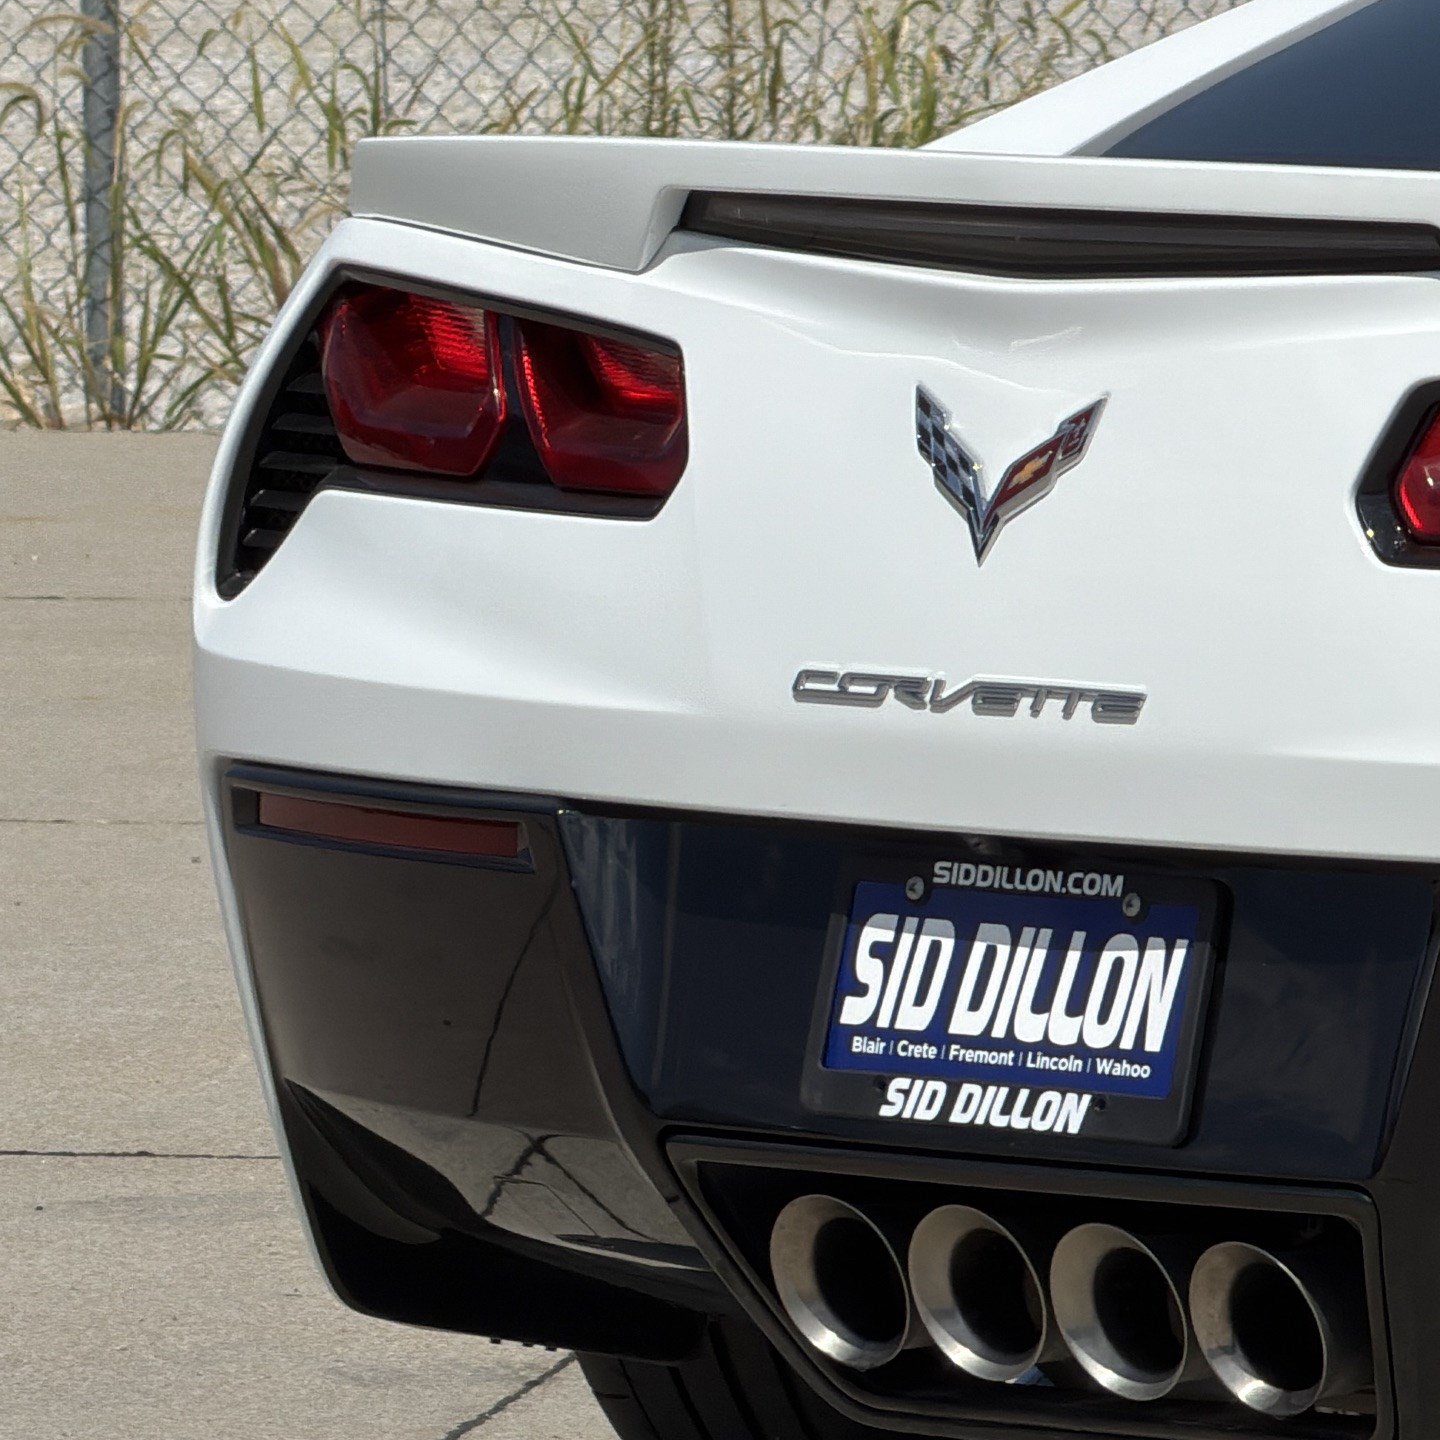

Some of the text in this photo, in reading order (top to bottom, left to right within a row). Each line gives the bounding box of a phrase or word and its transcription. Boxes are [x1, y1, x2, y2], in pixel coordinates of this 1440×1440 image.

[792, 664, 1147, 725] CORVETTE
[932, 861, 1124, 897] SIDDILLON.COM
[839, 913, 1190, 1053] SID DILLON
[851, 1035, 1151, 1079] Blair Crete Fremont Lincoln Wahoo
[878, 1077, 1093, 1135] SID DILLON
